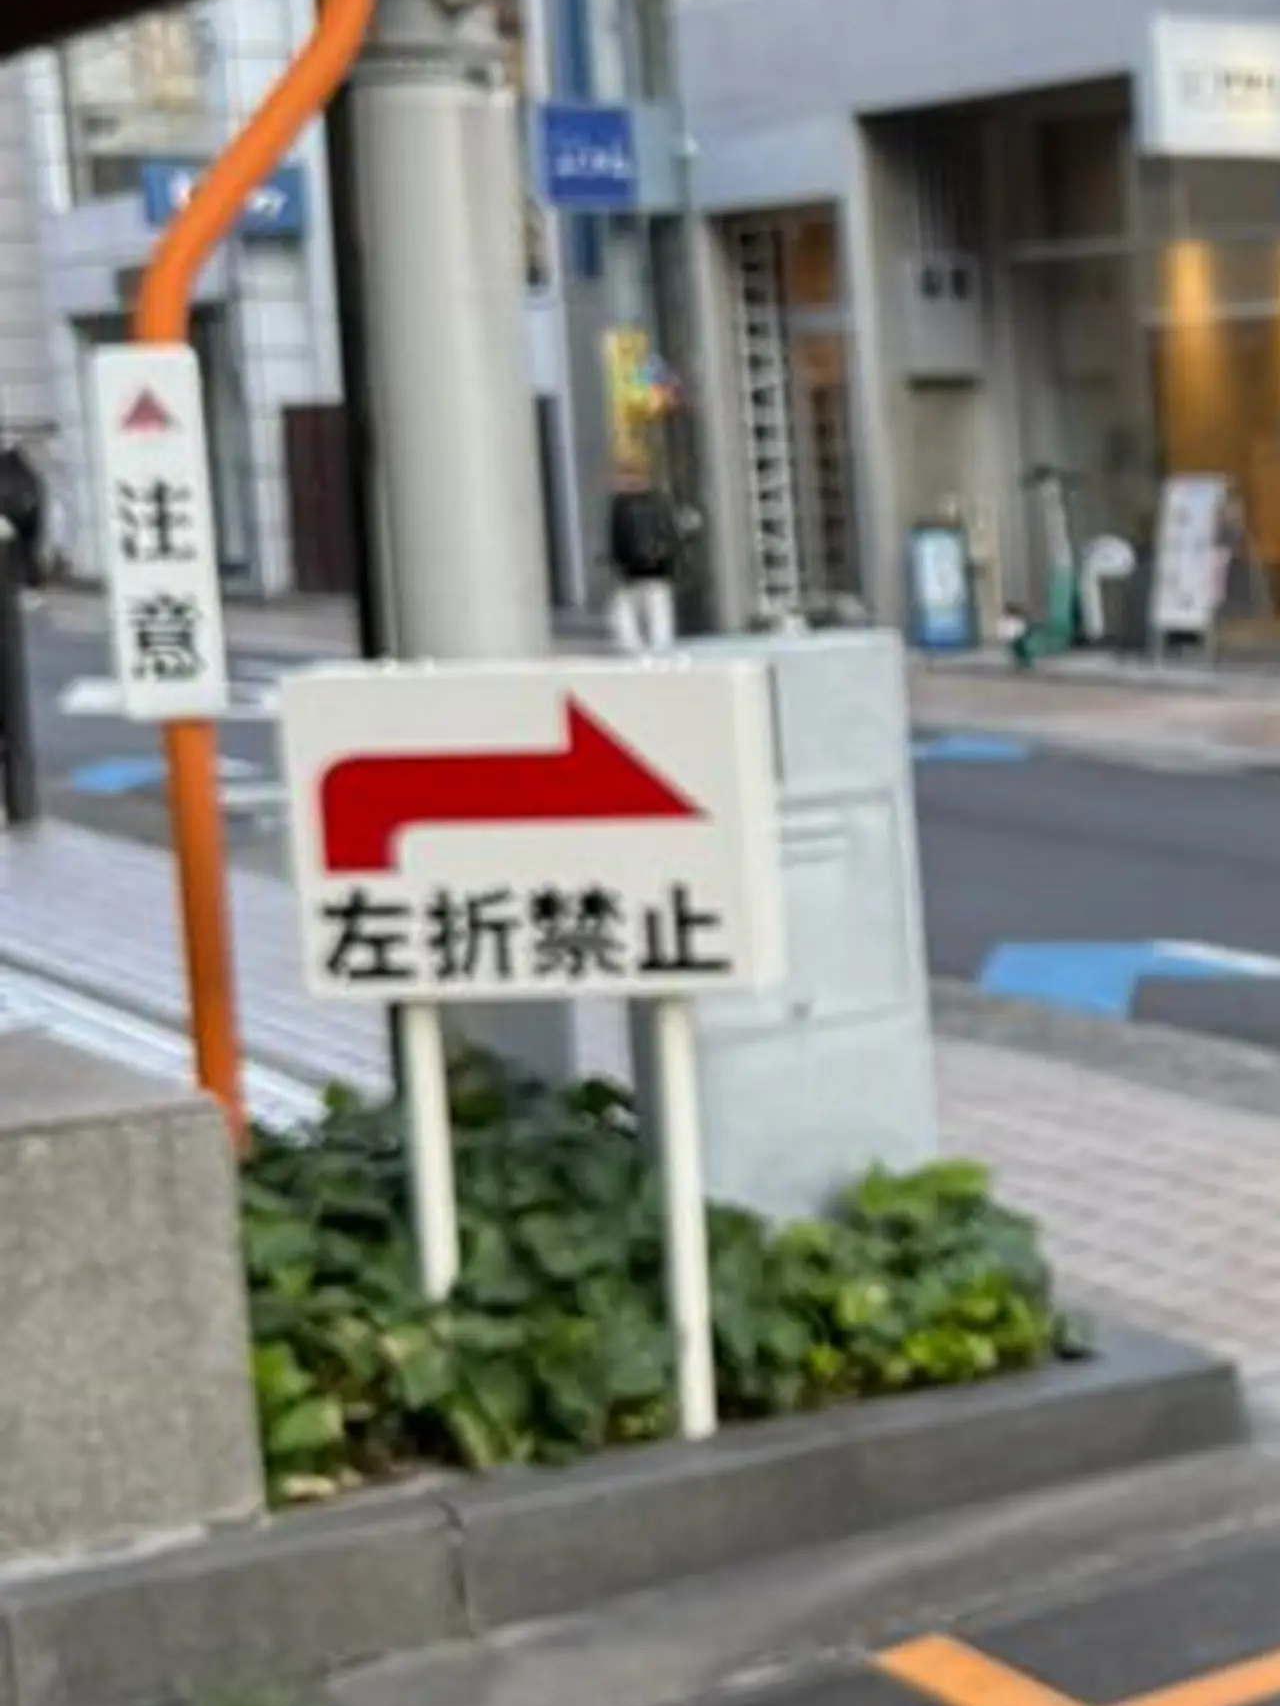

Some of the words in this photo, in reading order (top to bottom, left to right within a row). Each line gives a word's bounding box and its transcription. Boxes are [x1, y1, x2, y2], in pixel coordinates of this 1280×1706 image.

[118, 478, 205, 682] 注意
[320, 885, 732, 983] 左折禁止
